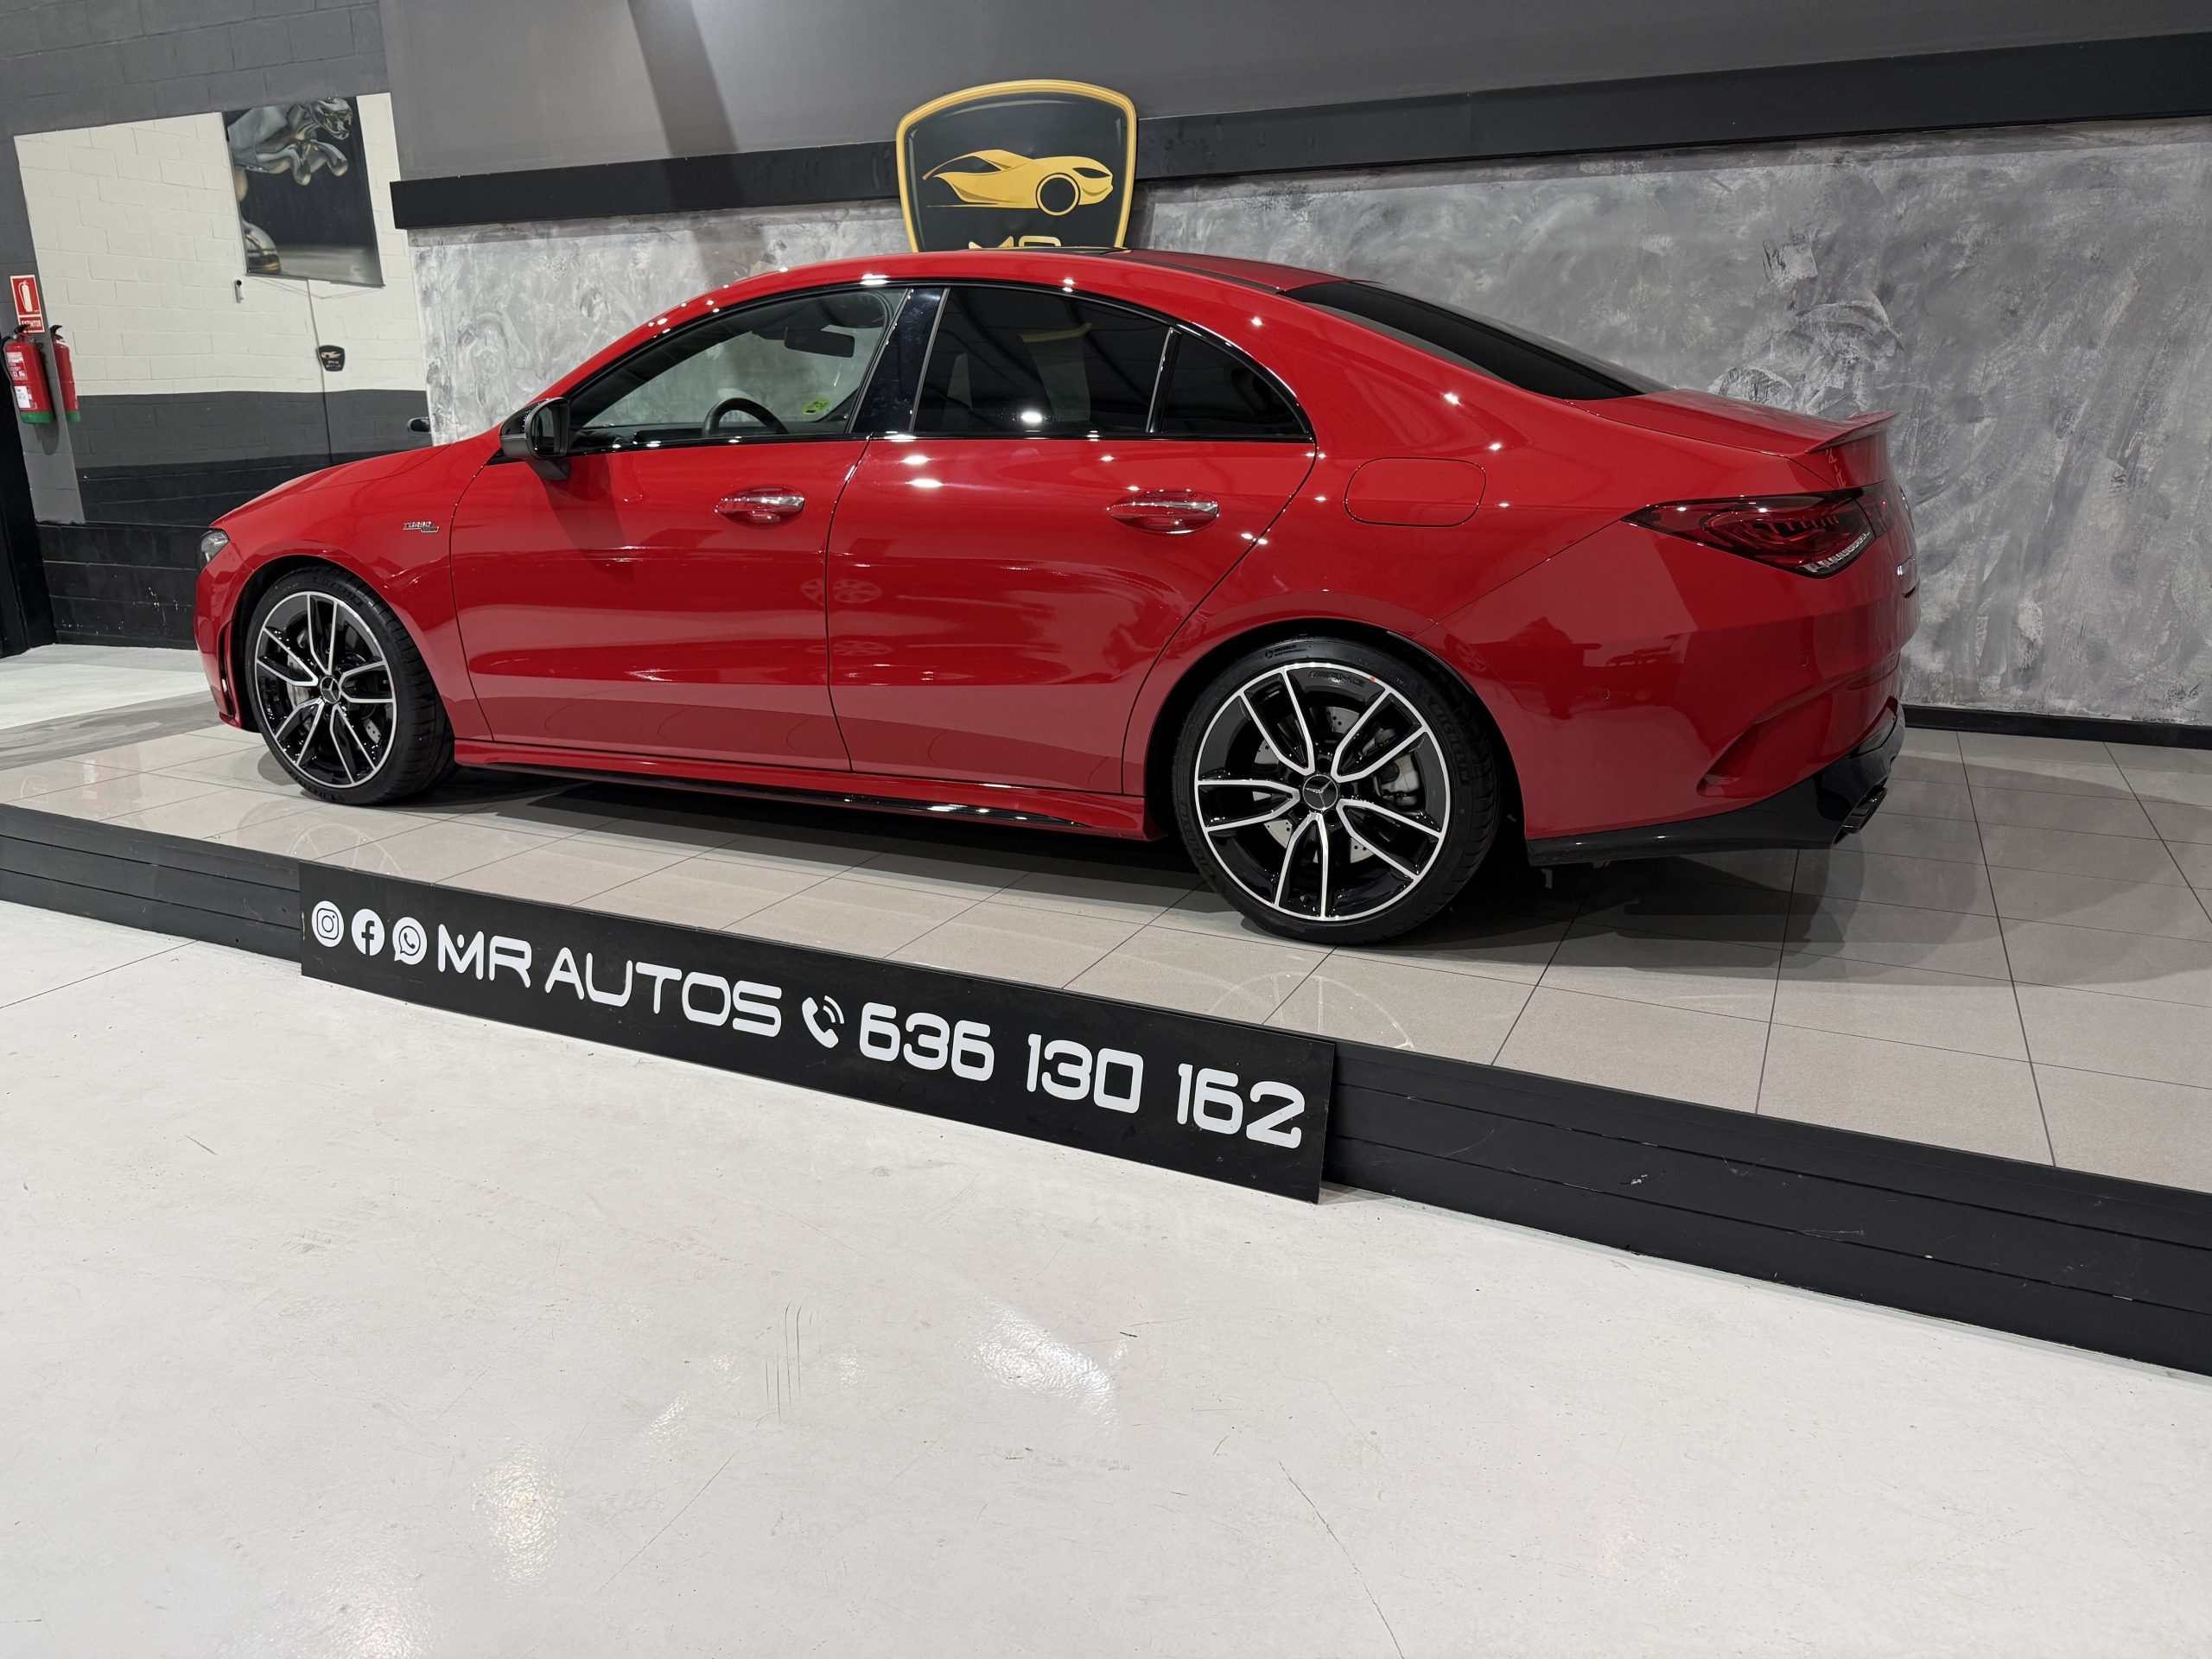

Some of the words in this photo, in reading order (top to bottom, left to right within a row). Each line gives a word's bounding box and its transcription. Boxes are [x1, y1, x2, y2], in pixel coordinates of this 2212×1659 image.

[438, 925, 531, 988] MR
[545, 947, 781, 1037] AUTOS
[860, 1002, 994, 1081] 636
[1027, 1034, 1143, 1113] 130
[1178, 1064, 1305, 1148] 162
